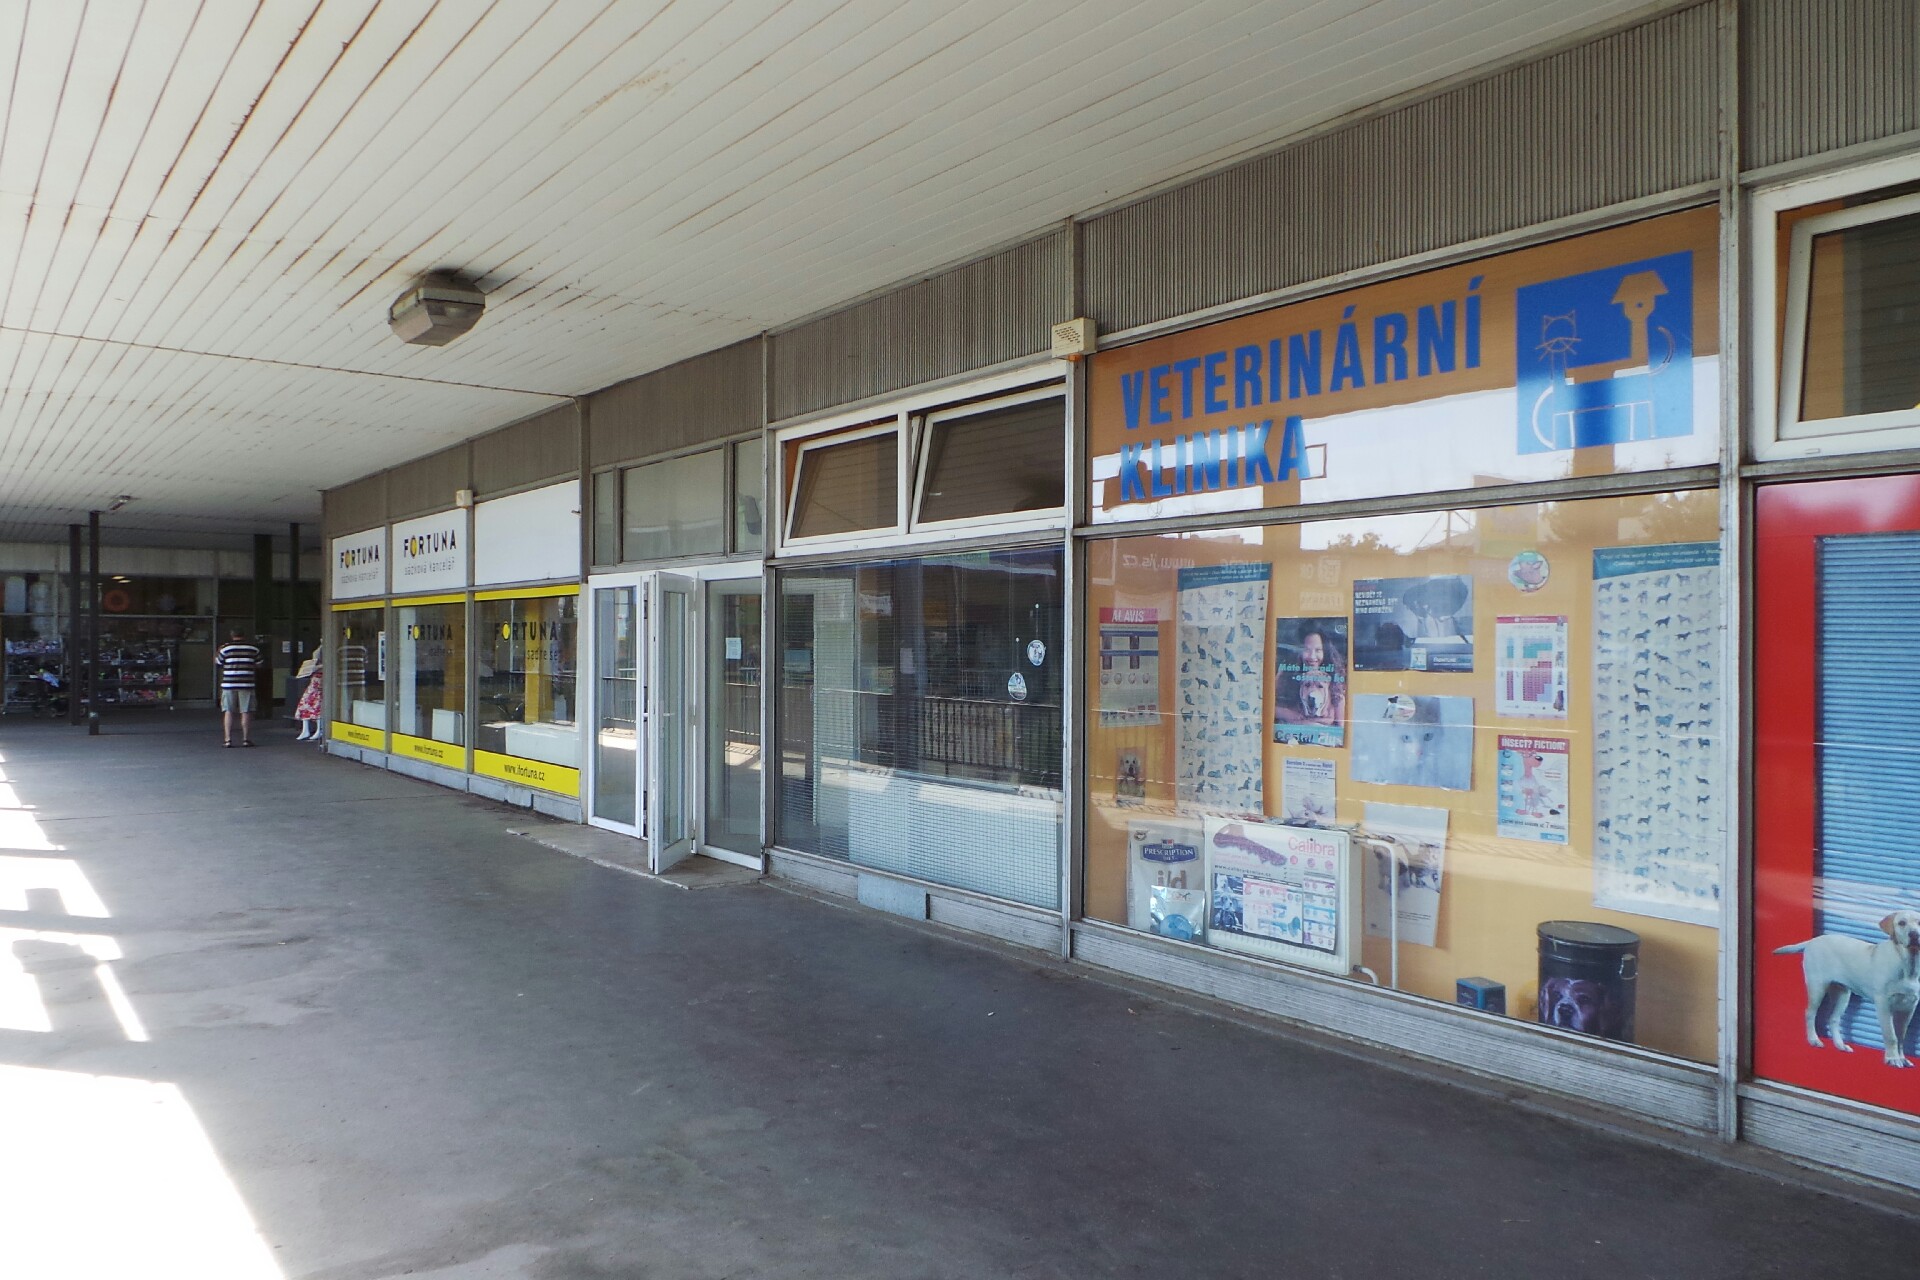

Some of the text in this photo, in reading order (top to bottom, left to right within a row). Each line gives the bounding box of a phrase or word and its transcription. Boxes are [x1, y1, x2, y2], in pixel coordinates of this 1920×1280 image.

[1120, 274, 1484, 430] VETERINÁRNÍ
[1120, 415, 1310, 501] KLINIKA
[403, 529, 457, 559] FORTUNA
[340, 544, 380, 569] FORTUNA
[1111, 609, 1144, 623] ALAVIS
[407, 624, 454, 640] FORTUNA
[495, 621, 558, 642] FORTUNA
[1501, 738, 1532, 749] INSECT?
[503, 763, 545, 782] www.ifortuna.cz
[1144, 847, 1194, 857] PRESCRIPTION
[1288, 836, 1336, 857] Calibra
